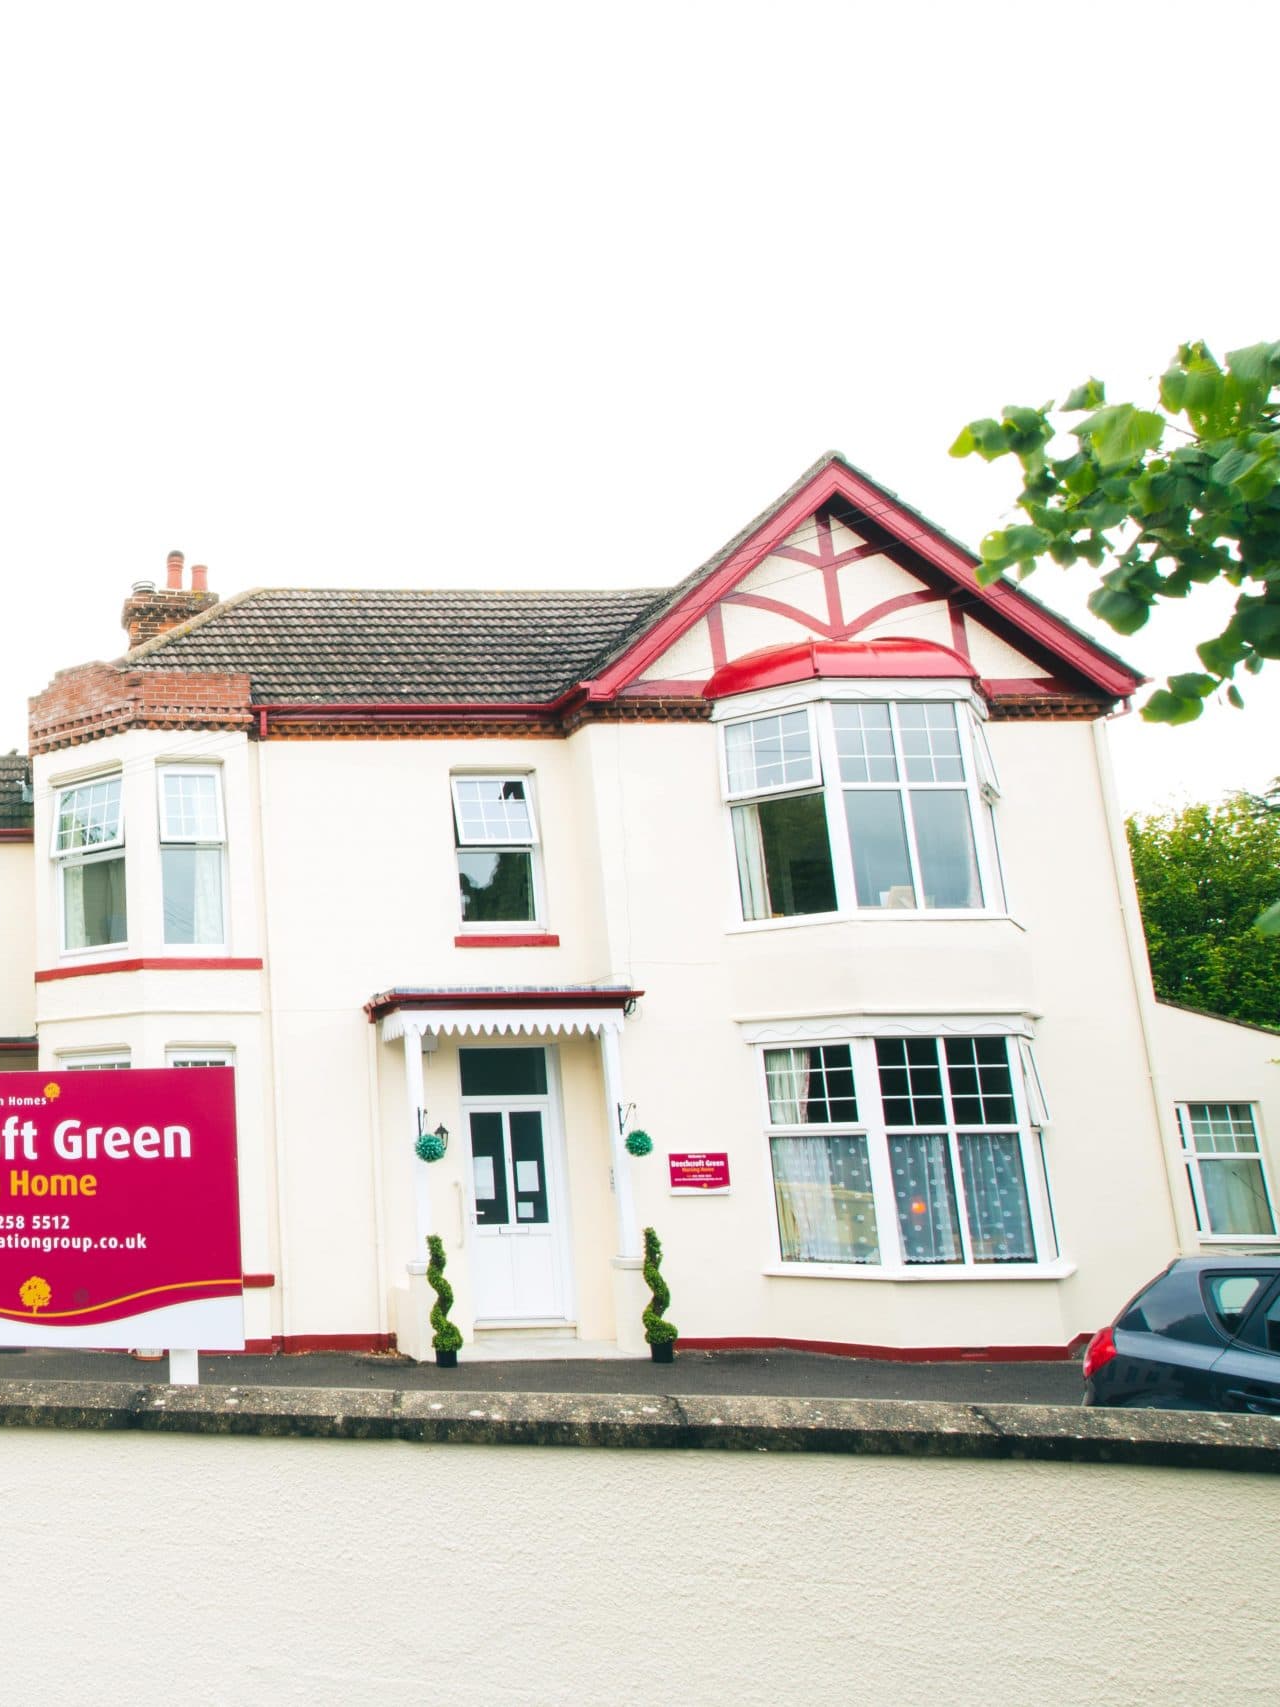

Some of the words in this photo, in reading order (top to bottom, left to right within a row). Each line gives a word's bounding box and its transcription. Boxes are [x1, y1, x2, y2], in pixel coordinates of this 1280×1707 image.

[8, 1095, 47, 1106] Homes
[53, 1119, 192, 1160] Green
[10, 1170, 97, 1197] Home
[31, 1215, 70, 1230] 5512
